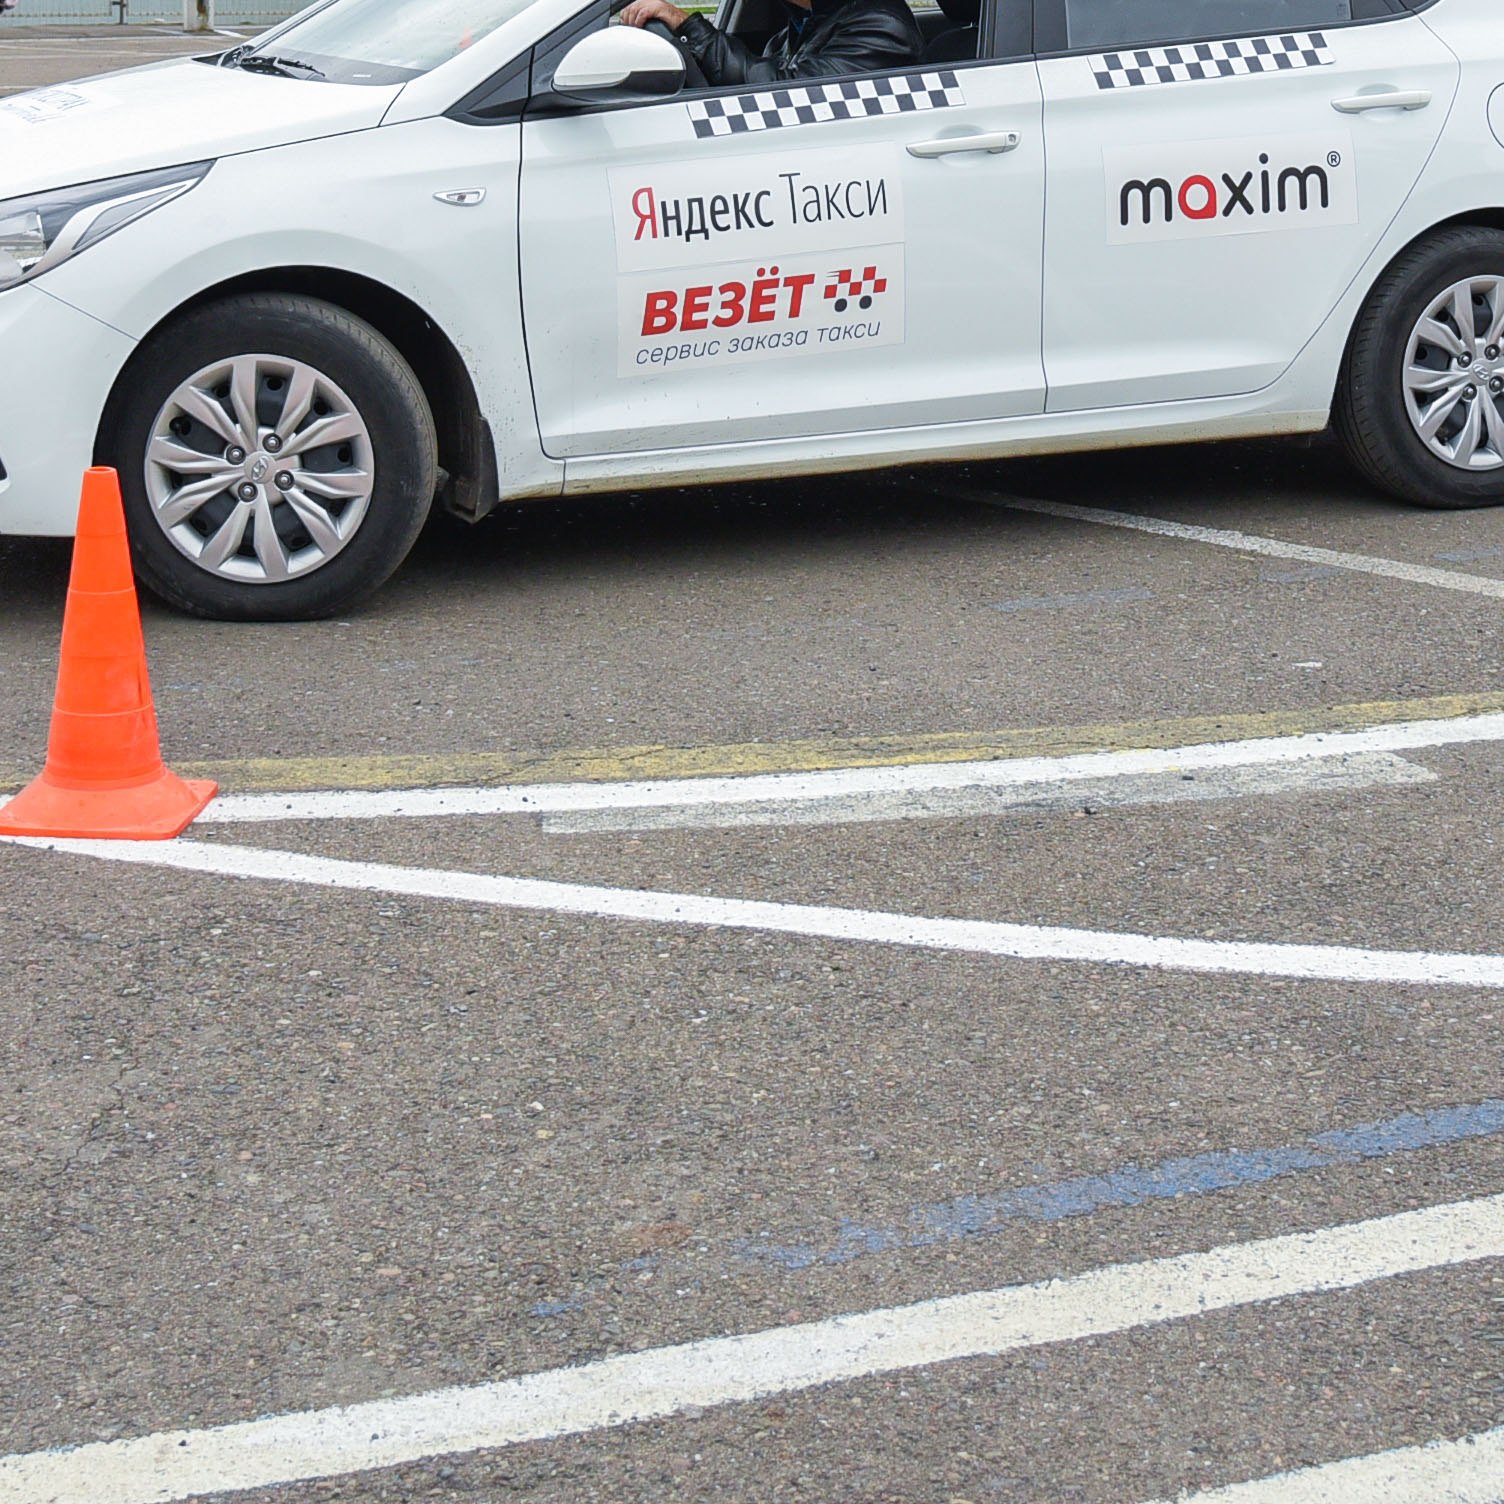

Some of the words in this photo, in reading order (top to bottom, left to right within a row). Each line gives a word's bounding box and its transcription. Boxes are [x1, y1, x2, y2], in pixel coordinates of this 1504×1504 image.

[631, 186, 774, 242] Яндекс
[778, 172, 888, 224] Такси
[640, 265, 815, 337] ВЕЗЁТ
[636, 339, 721, 366] сервис
[727, 329, 809, 354] заказа
[816, 321, 881, 343] такси
